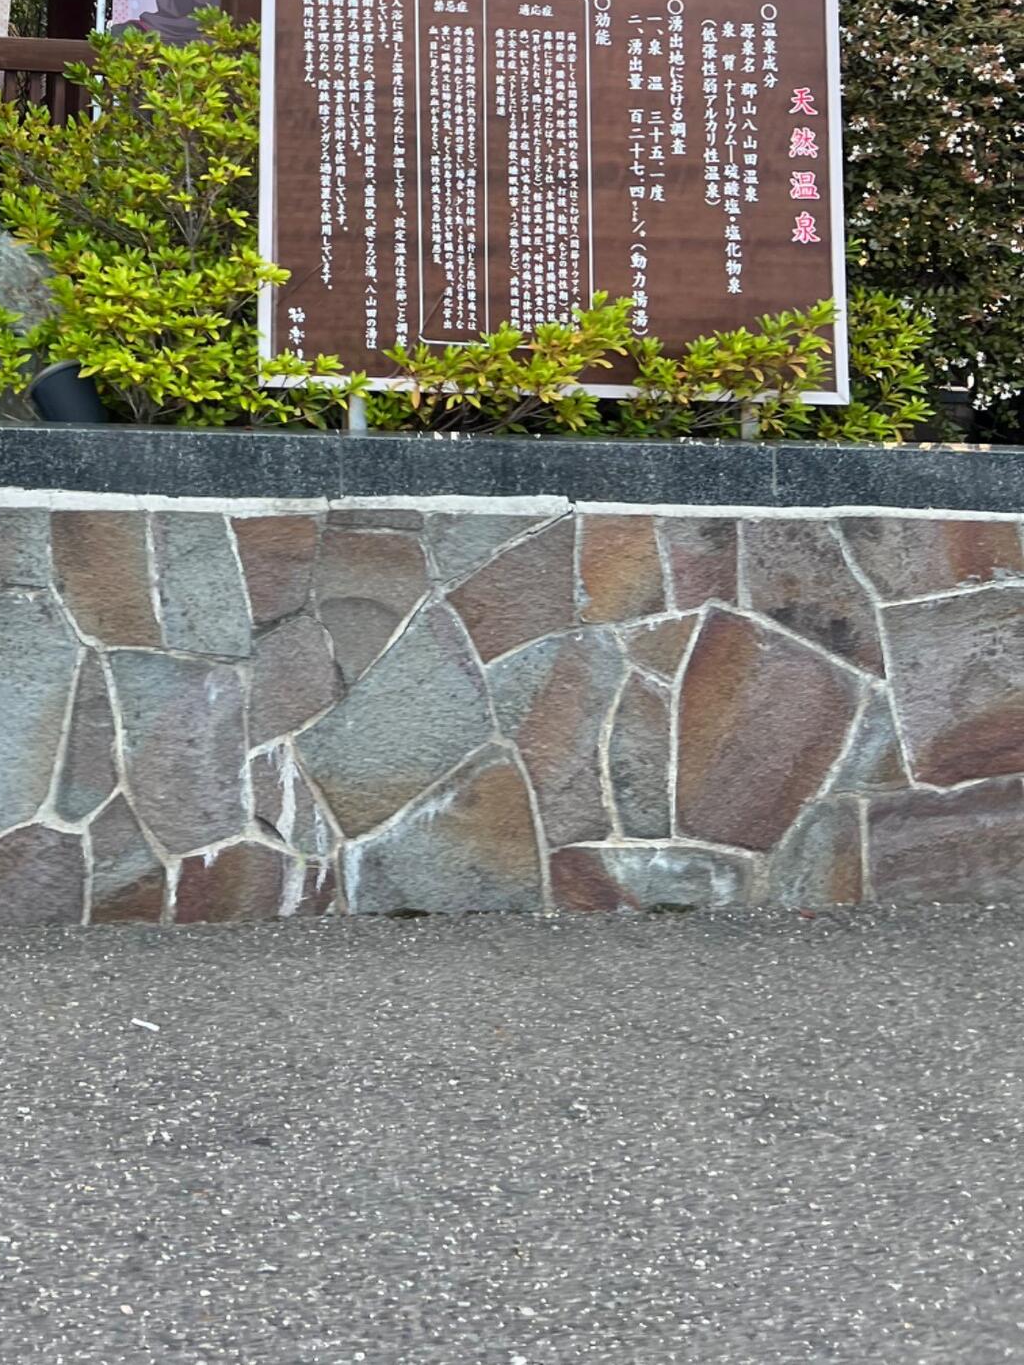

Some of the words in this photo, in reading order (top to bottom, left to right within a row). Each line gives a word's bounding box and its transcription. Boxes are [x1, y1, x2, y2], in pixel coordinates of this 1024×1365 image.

[761, 22, 778, 88] 温泉成分
[788, 87, 821, 244] 天然温泉
